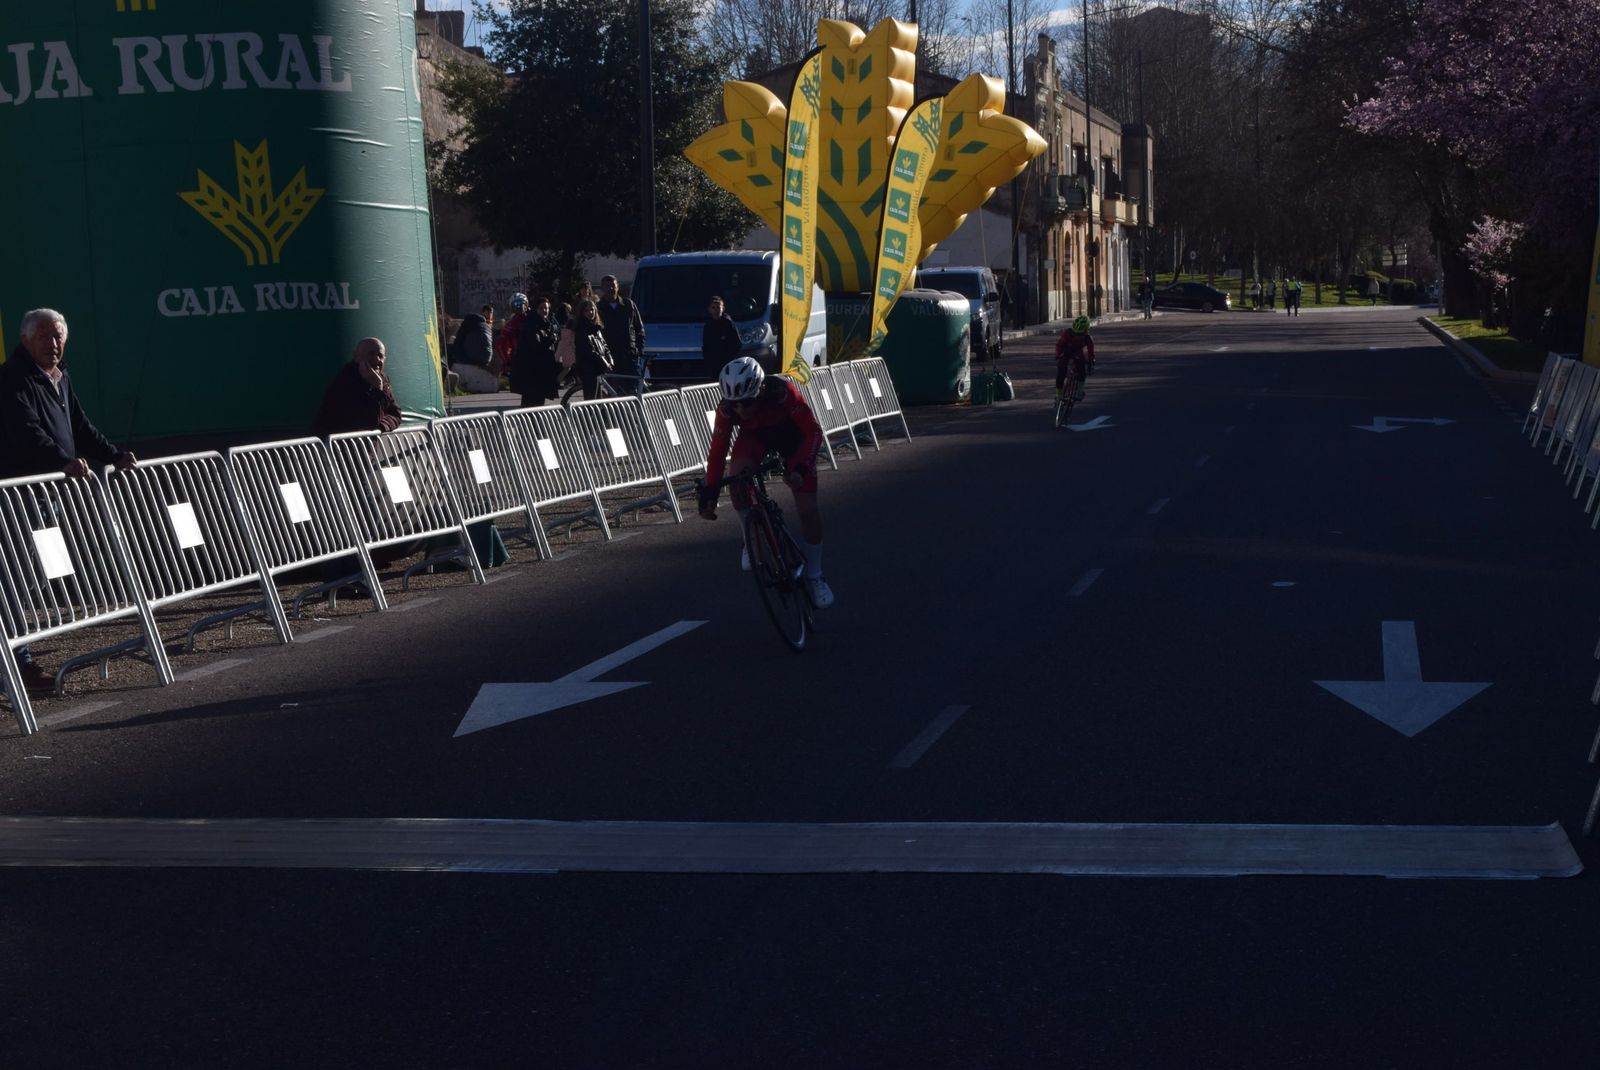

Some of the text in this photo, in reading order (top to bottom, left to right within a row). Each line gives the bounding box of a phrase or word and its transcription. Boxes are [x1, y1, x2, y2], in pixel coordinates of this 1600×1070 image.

[0, 41, 93, 106] JA
[113, 32, 353, 95] RURAL
[157, 282, 361, 318] CAJA RURAL
[826, 303, 871, 316] OUREN
